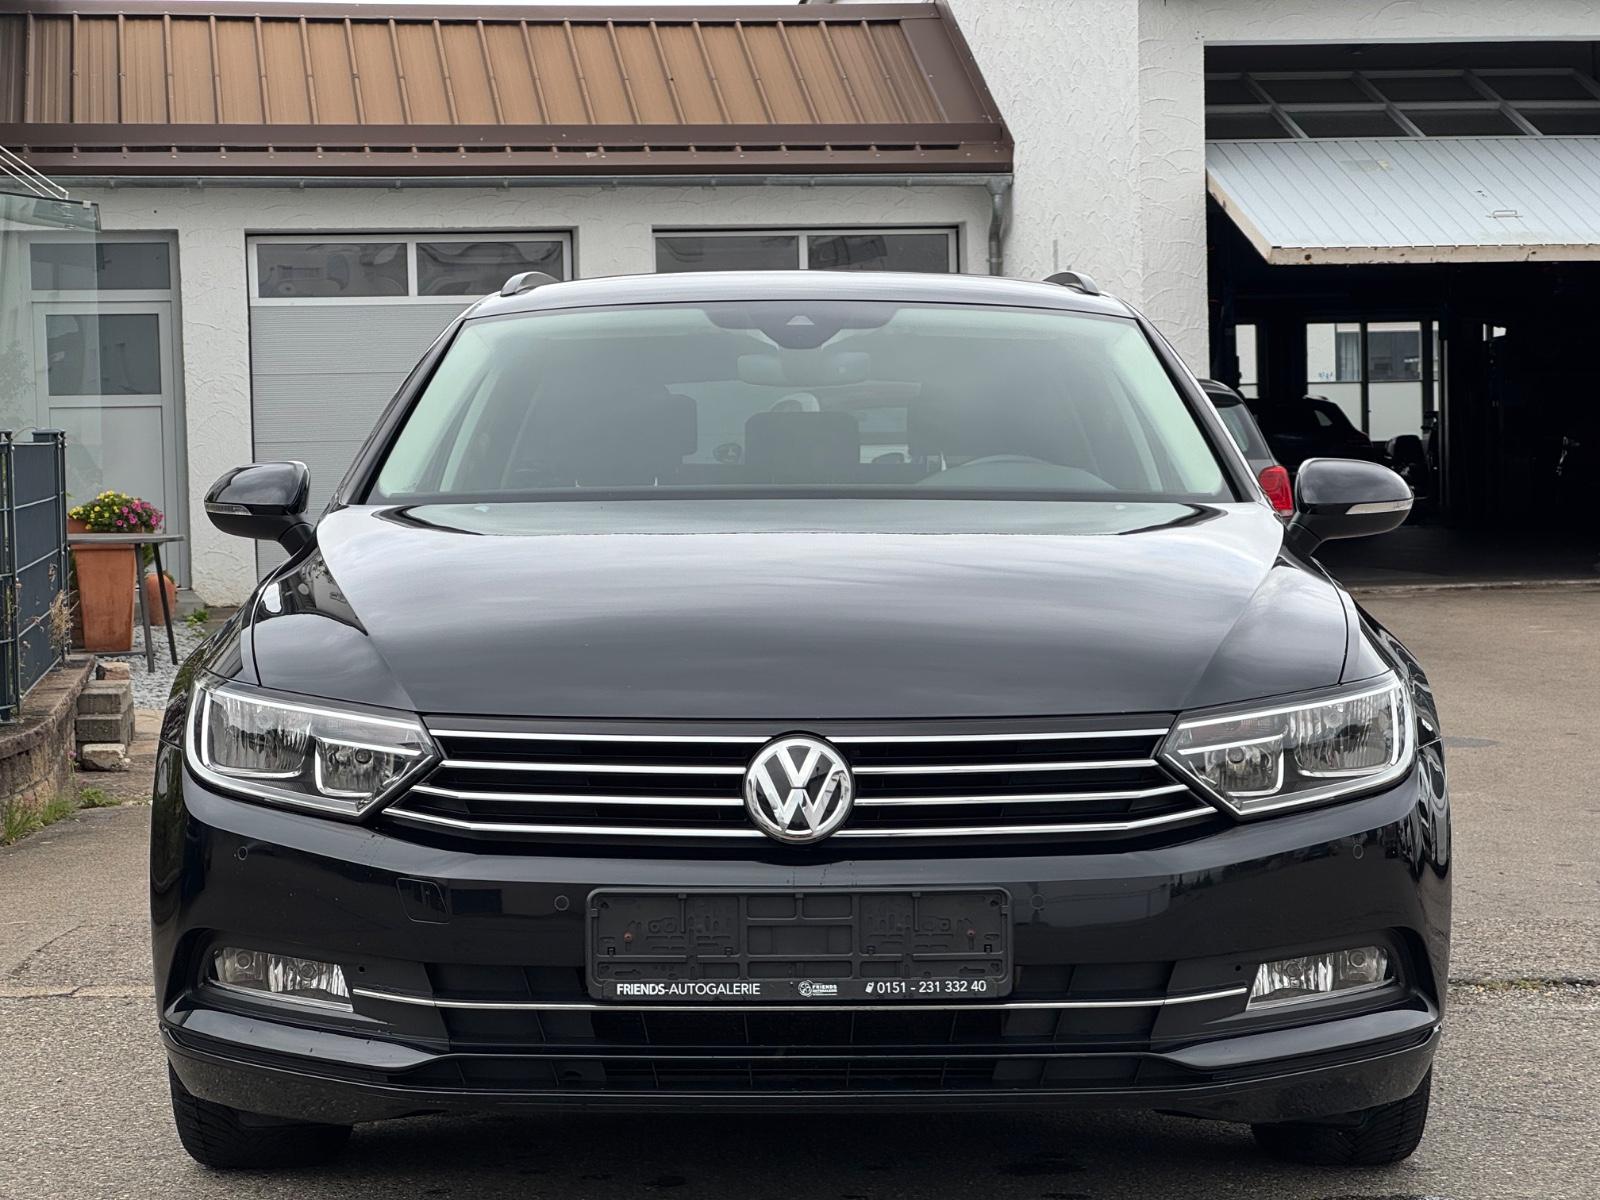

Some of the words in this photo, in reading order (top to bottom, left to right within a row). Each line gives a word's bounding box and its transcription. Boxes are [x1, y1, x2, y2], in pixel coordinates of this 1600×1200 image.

[749, 739, 847, 837] VW
[616, 982, 761, 996] FRIENDS-AUTOGALERIE
[876, 981, 906, 994] 0151
[918, 980, 941, 993] 231
[944, 980, 968, 993] 332
[970, 979, 987, 992] 40
